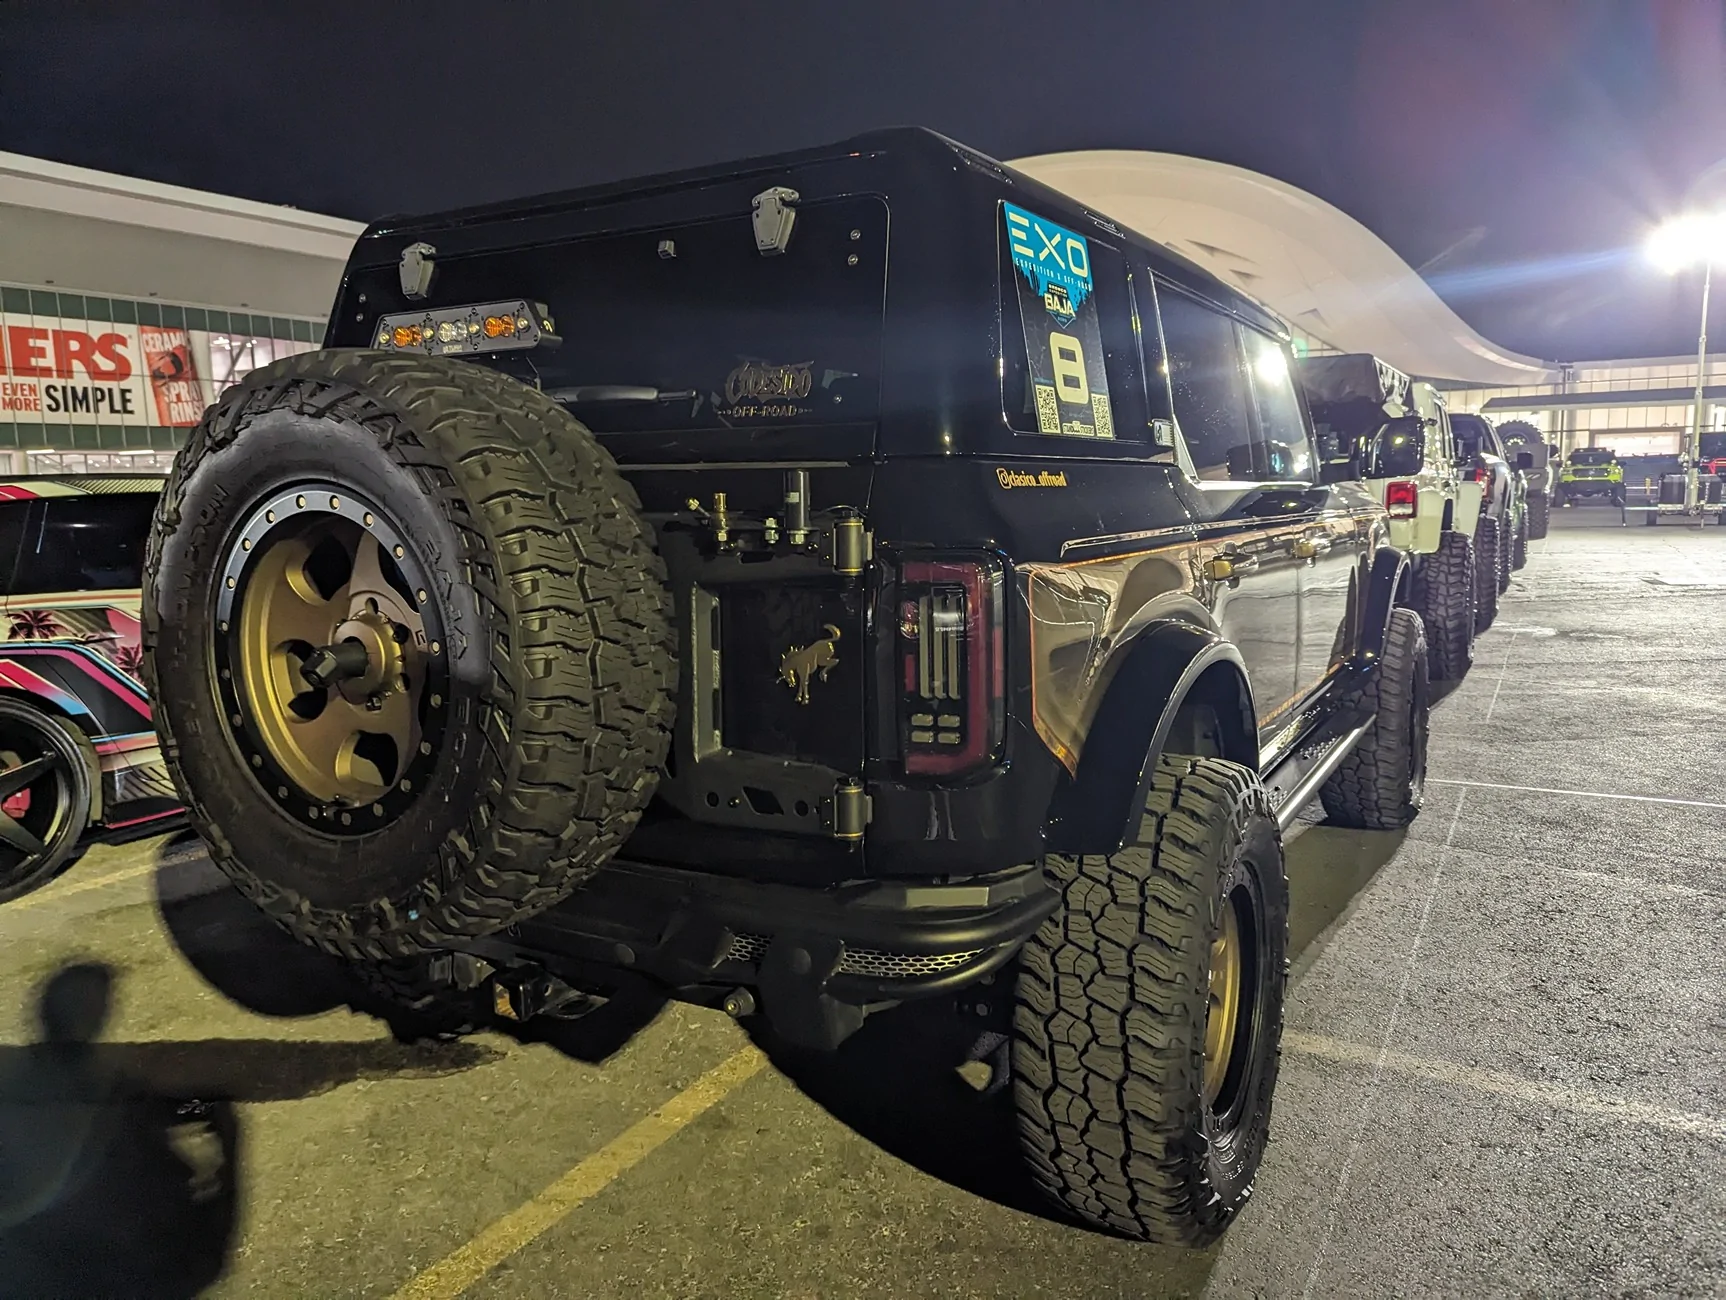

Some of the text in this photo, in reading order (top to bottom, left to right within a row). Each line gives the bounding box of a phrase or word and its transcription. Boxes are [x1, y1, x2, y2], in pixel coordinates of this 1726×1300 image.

[1008, 211, 1089, 278] EXO
[1044, 292, 1076, 318] BAJA
[0, 324, 132, 382] ERS
[1050, 331, 1089, 405] 8
[2, 382, 38, 397] EVEN
[45, 384, 135, 415] SIMPLE
[2, 397, 42, 412] MORE
[170, 401, 205, 423] RINS
[732, 404, 798, 418] OFF-ROAD
